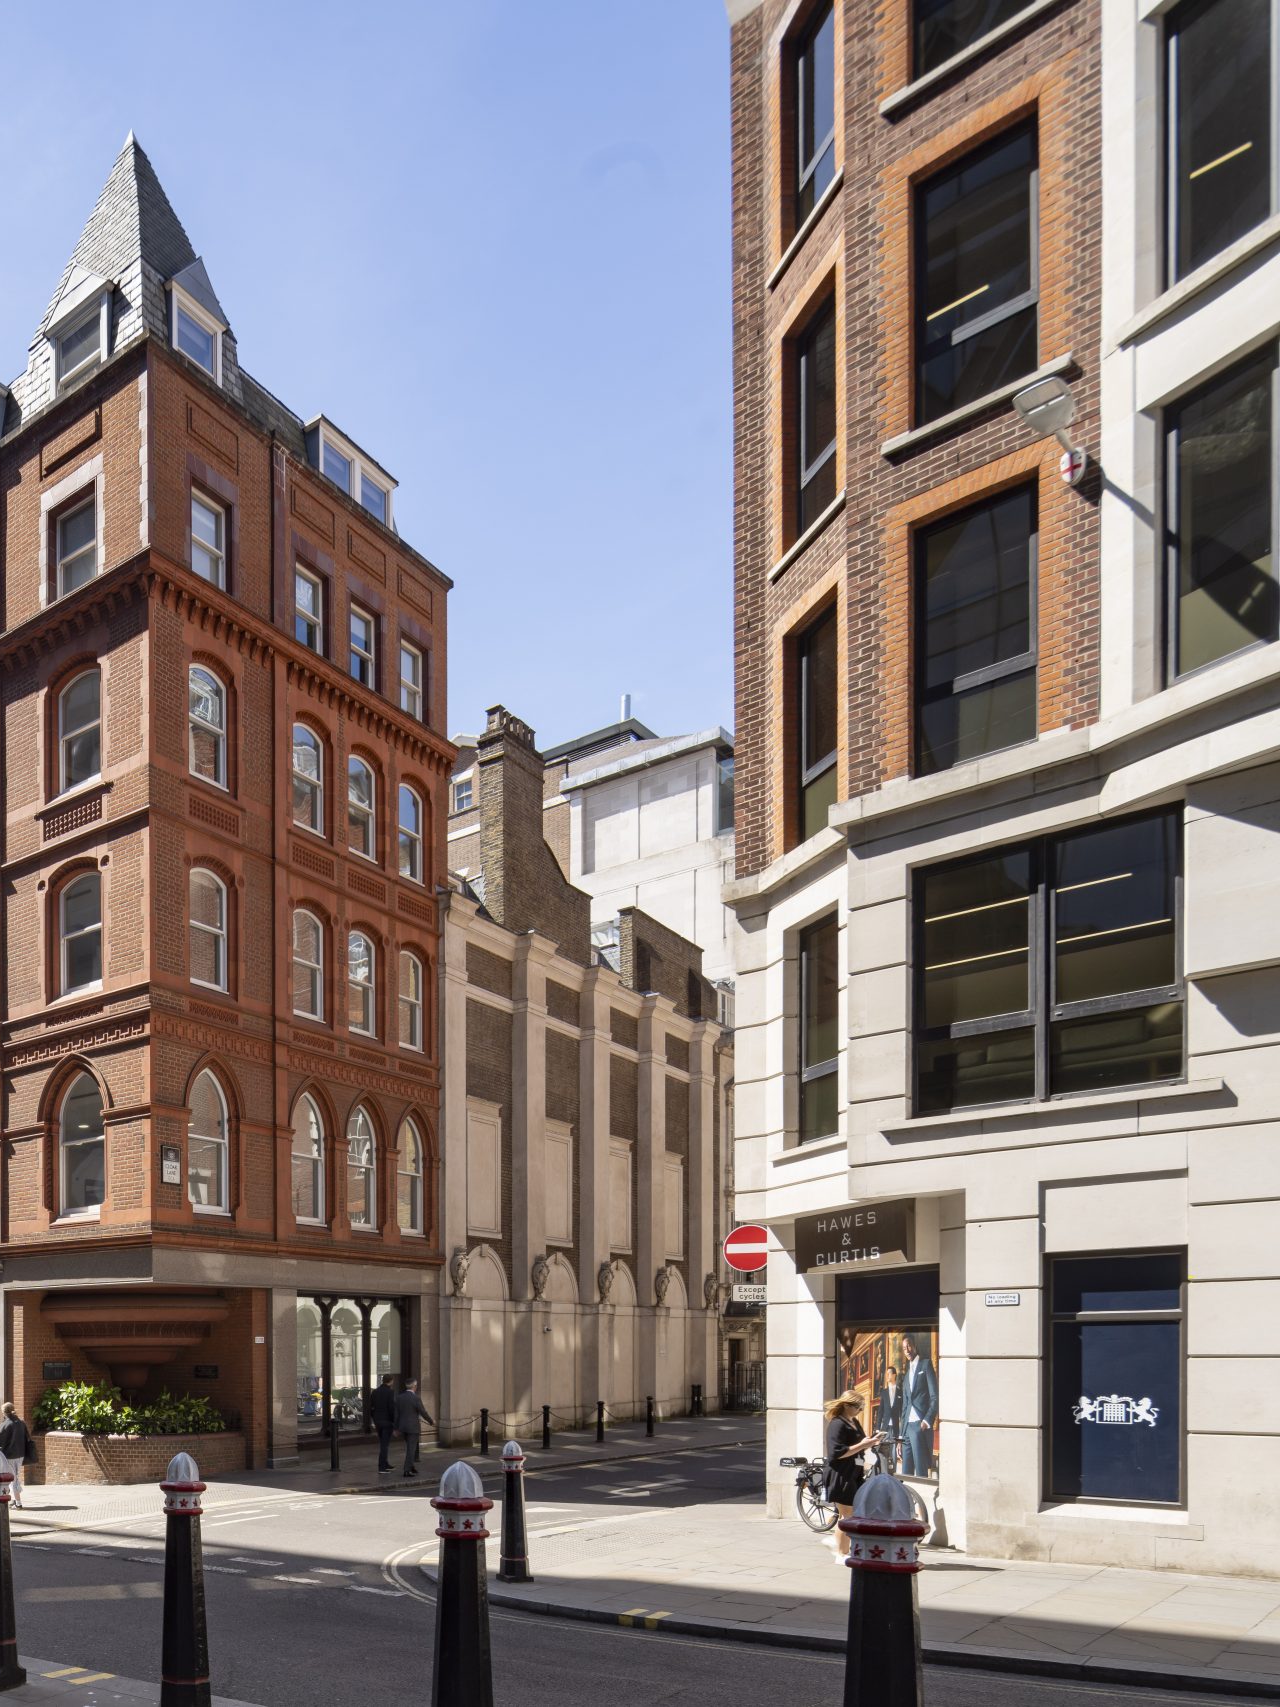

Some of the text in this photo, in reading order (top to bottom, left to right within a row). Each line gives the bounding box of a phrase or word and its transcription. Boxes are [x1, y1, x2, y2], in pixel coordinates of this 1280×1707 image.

[817, 1211, 877, 1233] HAWES
[841, 1233, 852, 1246] &
[816, 1246, 880, 1266] CURTIS
[739, 1293, 765, 1301] cycles
